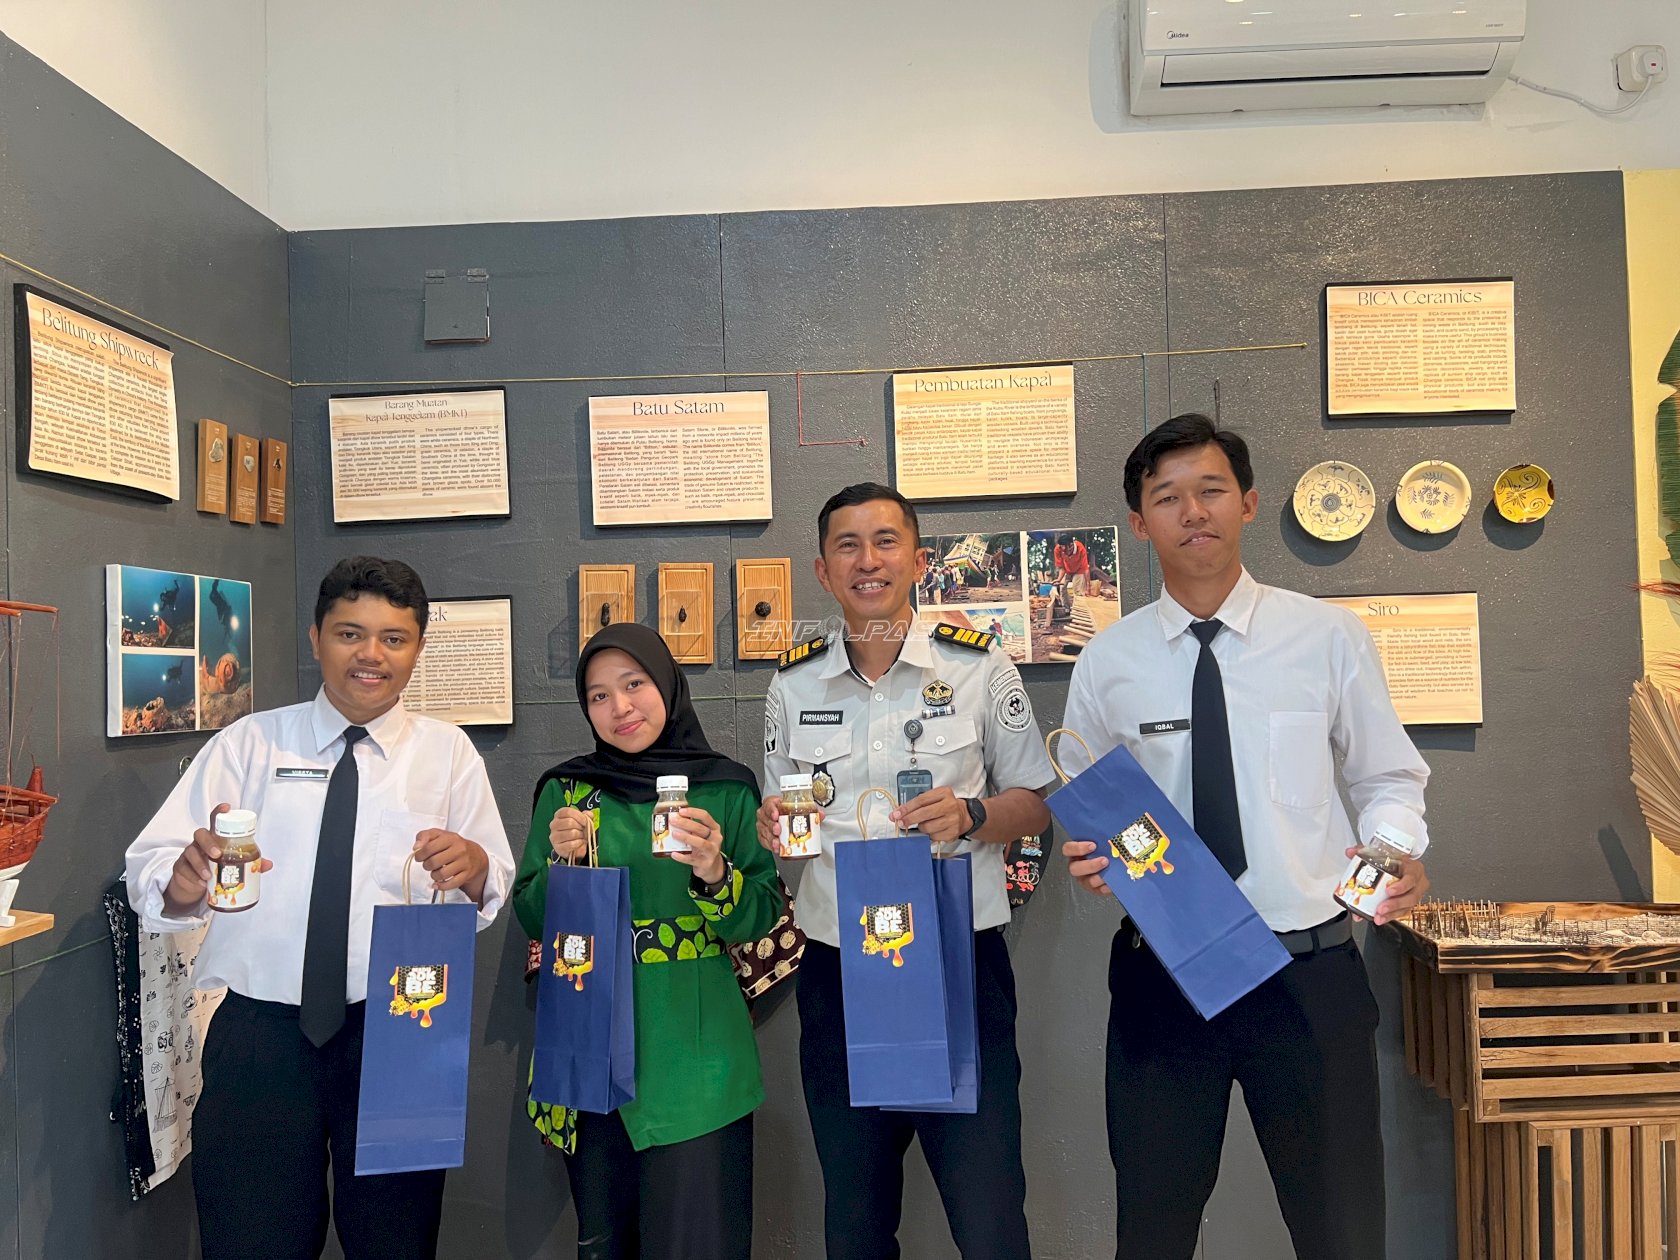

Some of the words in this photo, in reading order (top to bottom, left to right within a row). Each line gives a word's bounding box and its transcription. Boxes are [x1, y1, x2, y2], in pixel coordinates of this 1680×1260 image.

[1166, 30, 1189, 39] Midea
[1358, 290, 1398, 306] BICA
[1403, 288, 1482, 305] Ceramics
[42, 307, 98, 350] Belitung
[100, 332, 160, 370] Shipwreck
[914, 375, 1004, 393] Pembuatan
[1009, 370, 1052, 392] Kapal
[416, 398, 448, 408] Muatan
[633, 400, 668, 416] Batu
[674, 399, 725, 415] Satam
[1367, 602, 1400, 617] Siro
[802, 713, 839, 723] PIRMANSYAH
